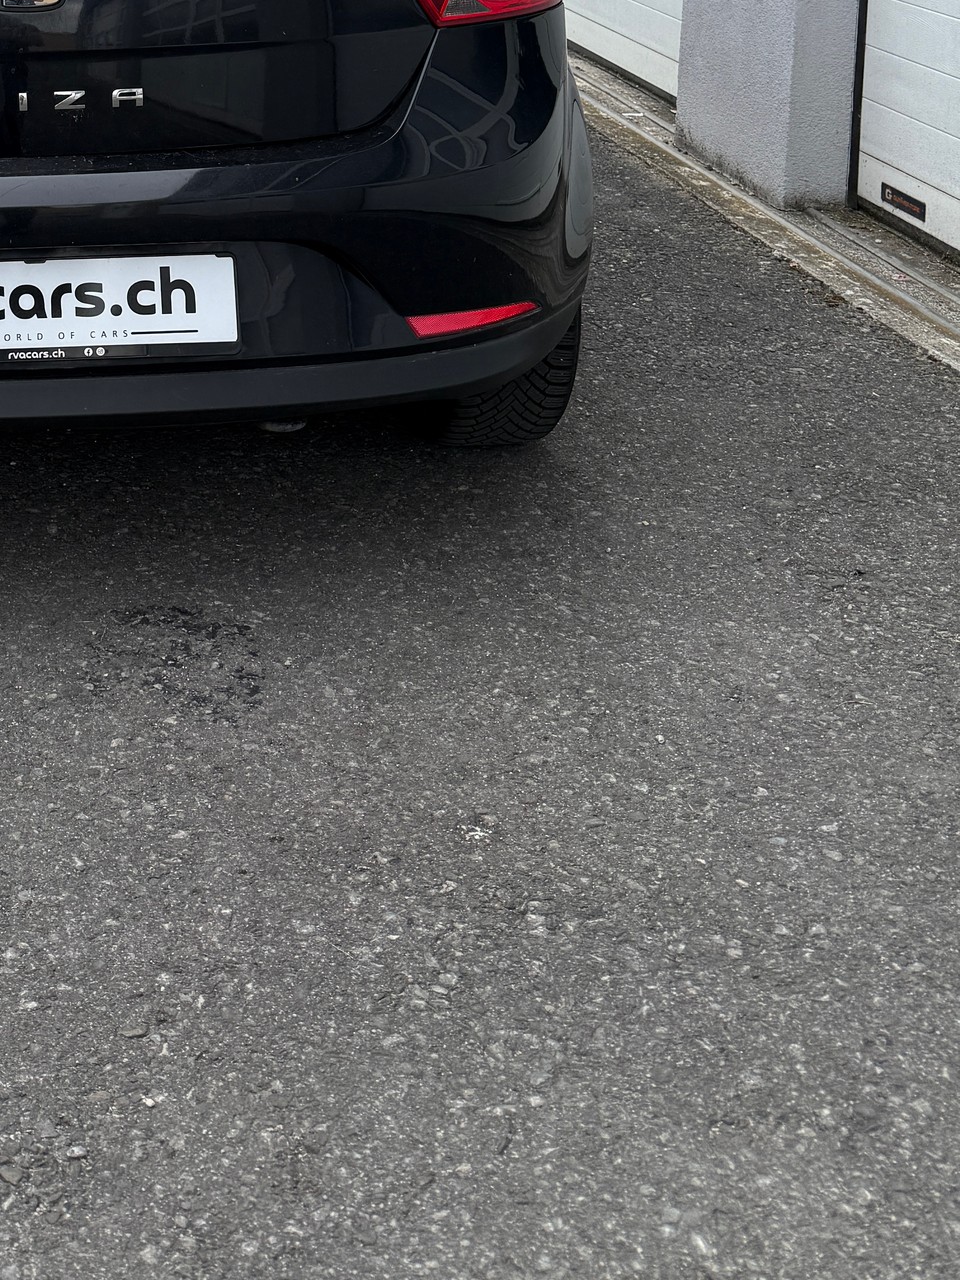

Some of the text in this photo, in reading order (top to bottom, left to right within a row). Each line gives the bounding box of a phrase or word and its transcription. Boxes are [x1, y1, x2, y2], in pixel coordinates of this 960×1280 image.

[57, 331, 76, 340] OF
[90, 329, 129, 339] CARS
[8, 348, 66, 360] rvacars.ch
